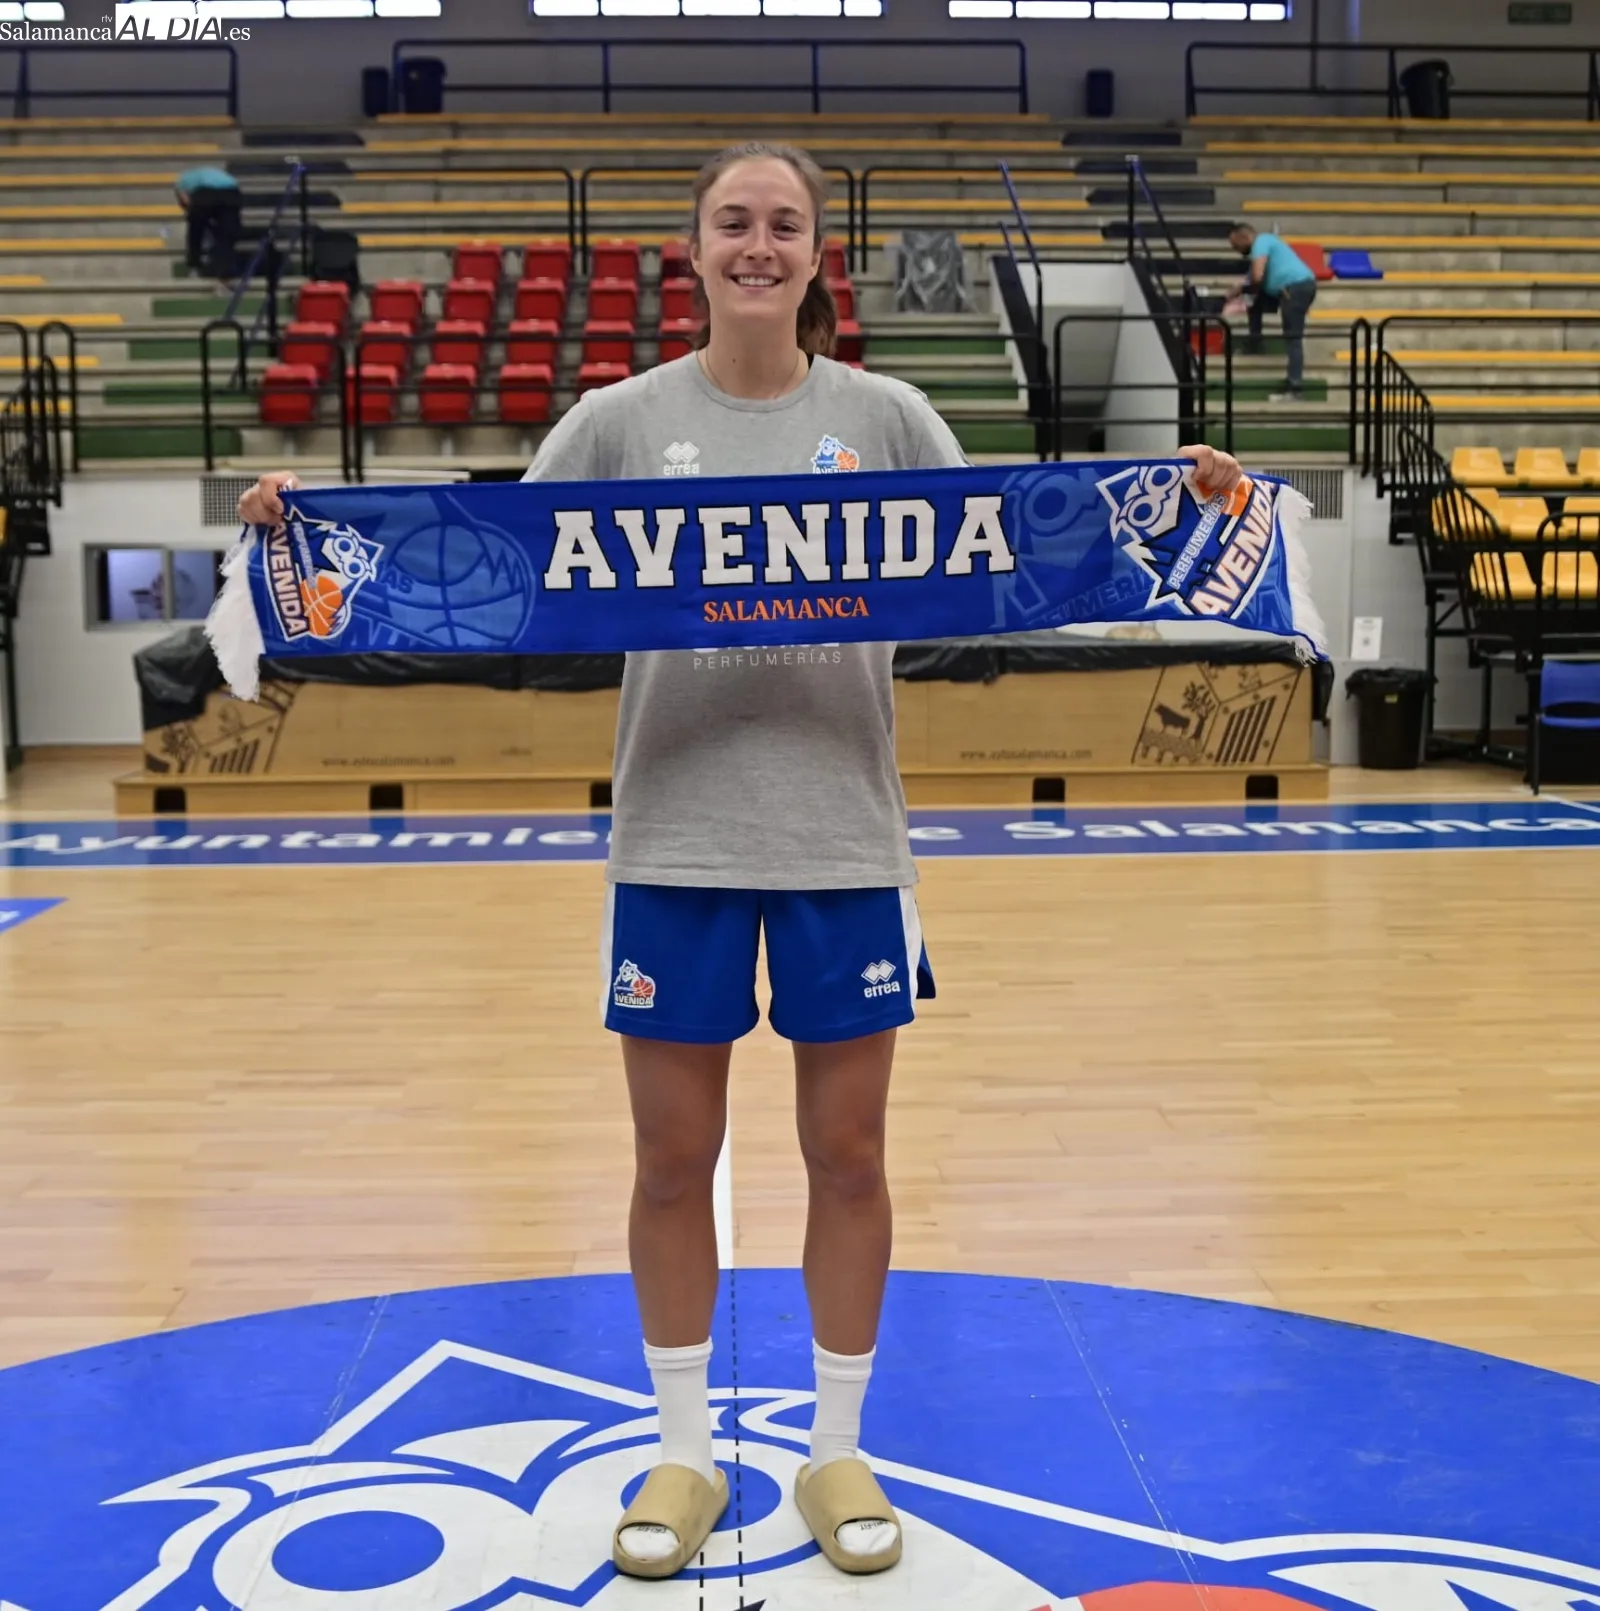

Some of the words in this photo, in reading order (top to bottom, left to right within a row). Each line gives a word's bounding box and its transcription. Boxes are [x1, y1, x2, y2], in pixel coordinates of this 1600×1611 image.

[543, 495, 1016, 591] AVENIDA
[1167, 491, 1228, 589] PERFUMERÍAS
[270, 521, 308, 635] AVENIDA
[703, 596, 869, 623] SALAMANCA
[693, 649, 842, 671] PERFUMERÍAS
[0, 828, 612, 855] Ayuntamie
[1003, 817, 1600, 840] Salamanca
[864, 981, 901, 998] errea
